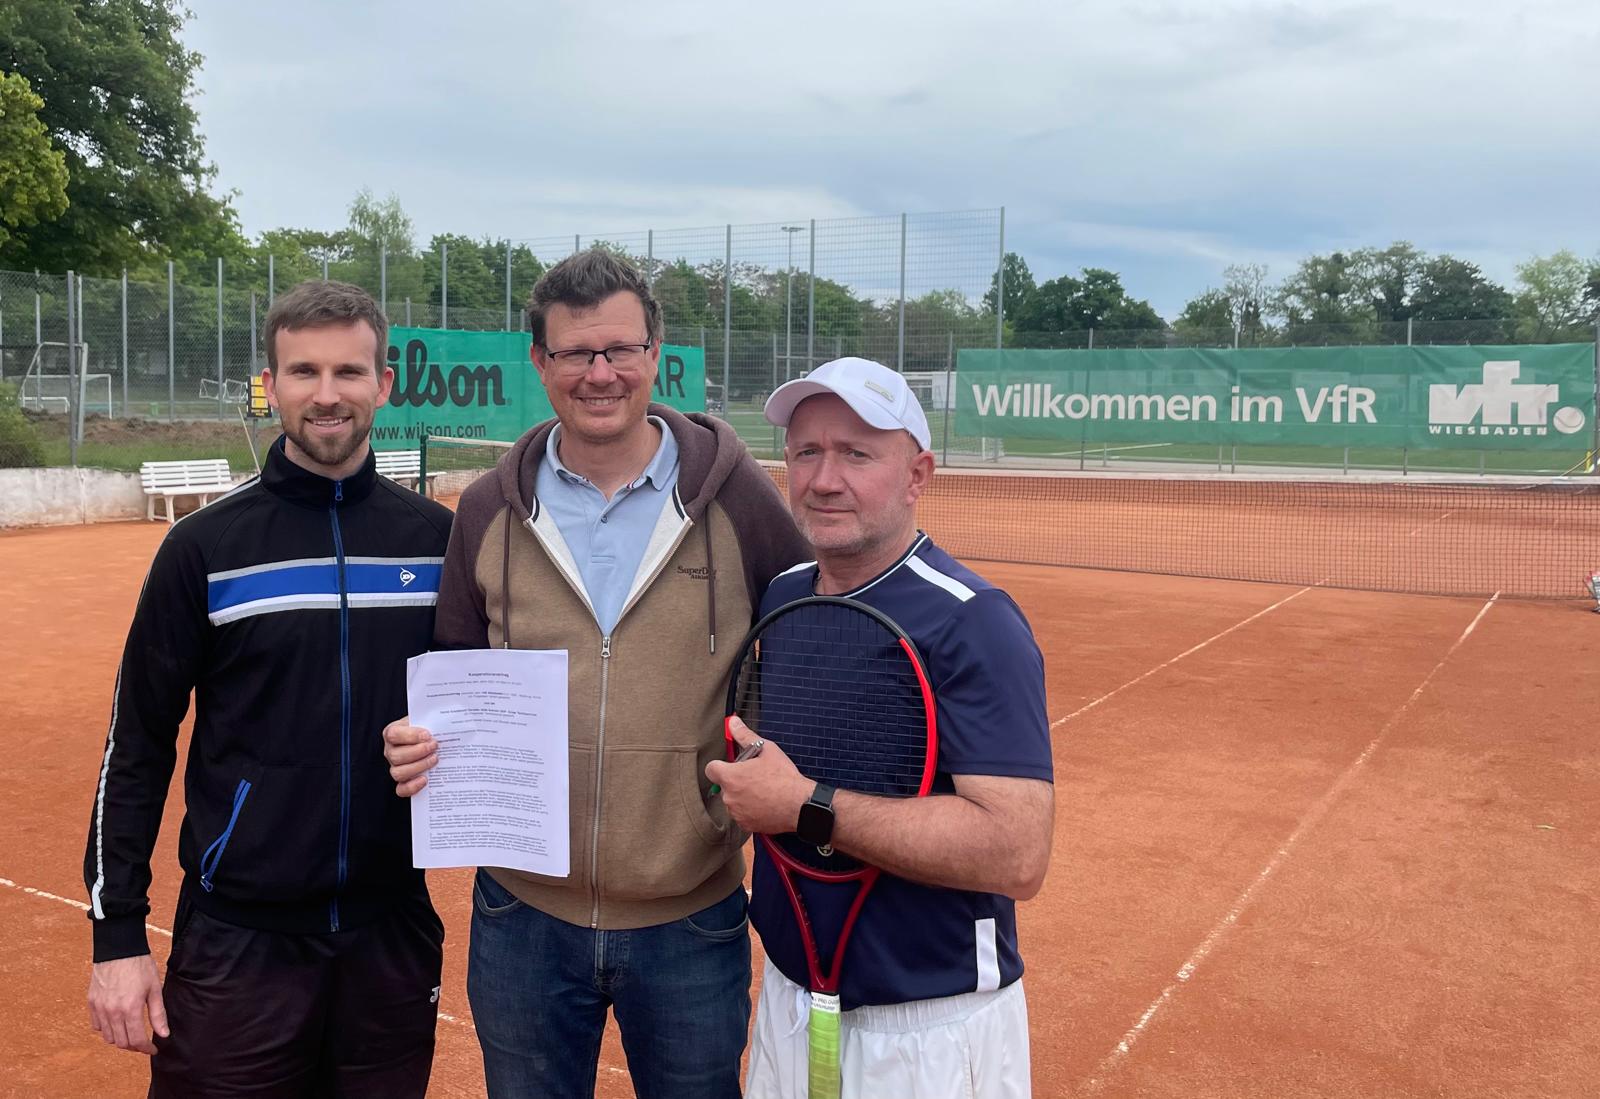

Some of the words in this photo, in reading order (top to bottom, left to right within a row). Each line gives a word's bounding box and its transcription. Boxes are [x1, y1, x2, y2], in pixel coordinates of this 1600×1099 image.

[387, 339, 506, 408] ilson
[971, 383, 1217, 421] Willkommen
[1231, 385, 1283, 423] im
[1295, 384, 1378, 424] VfR
[1428, 424, 1548, 436] WIESBADEN
[677, 565, 717, 575] SuperDy
